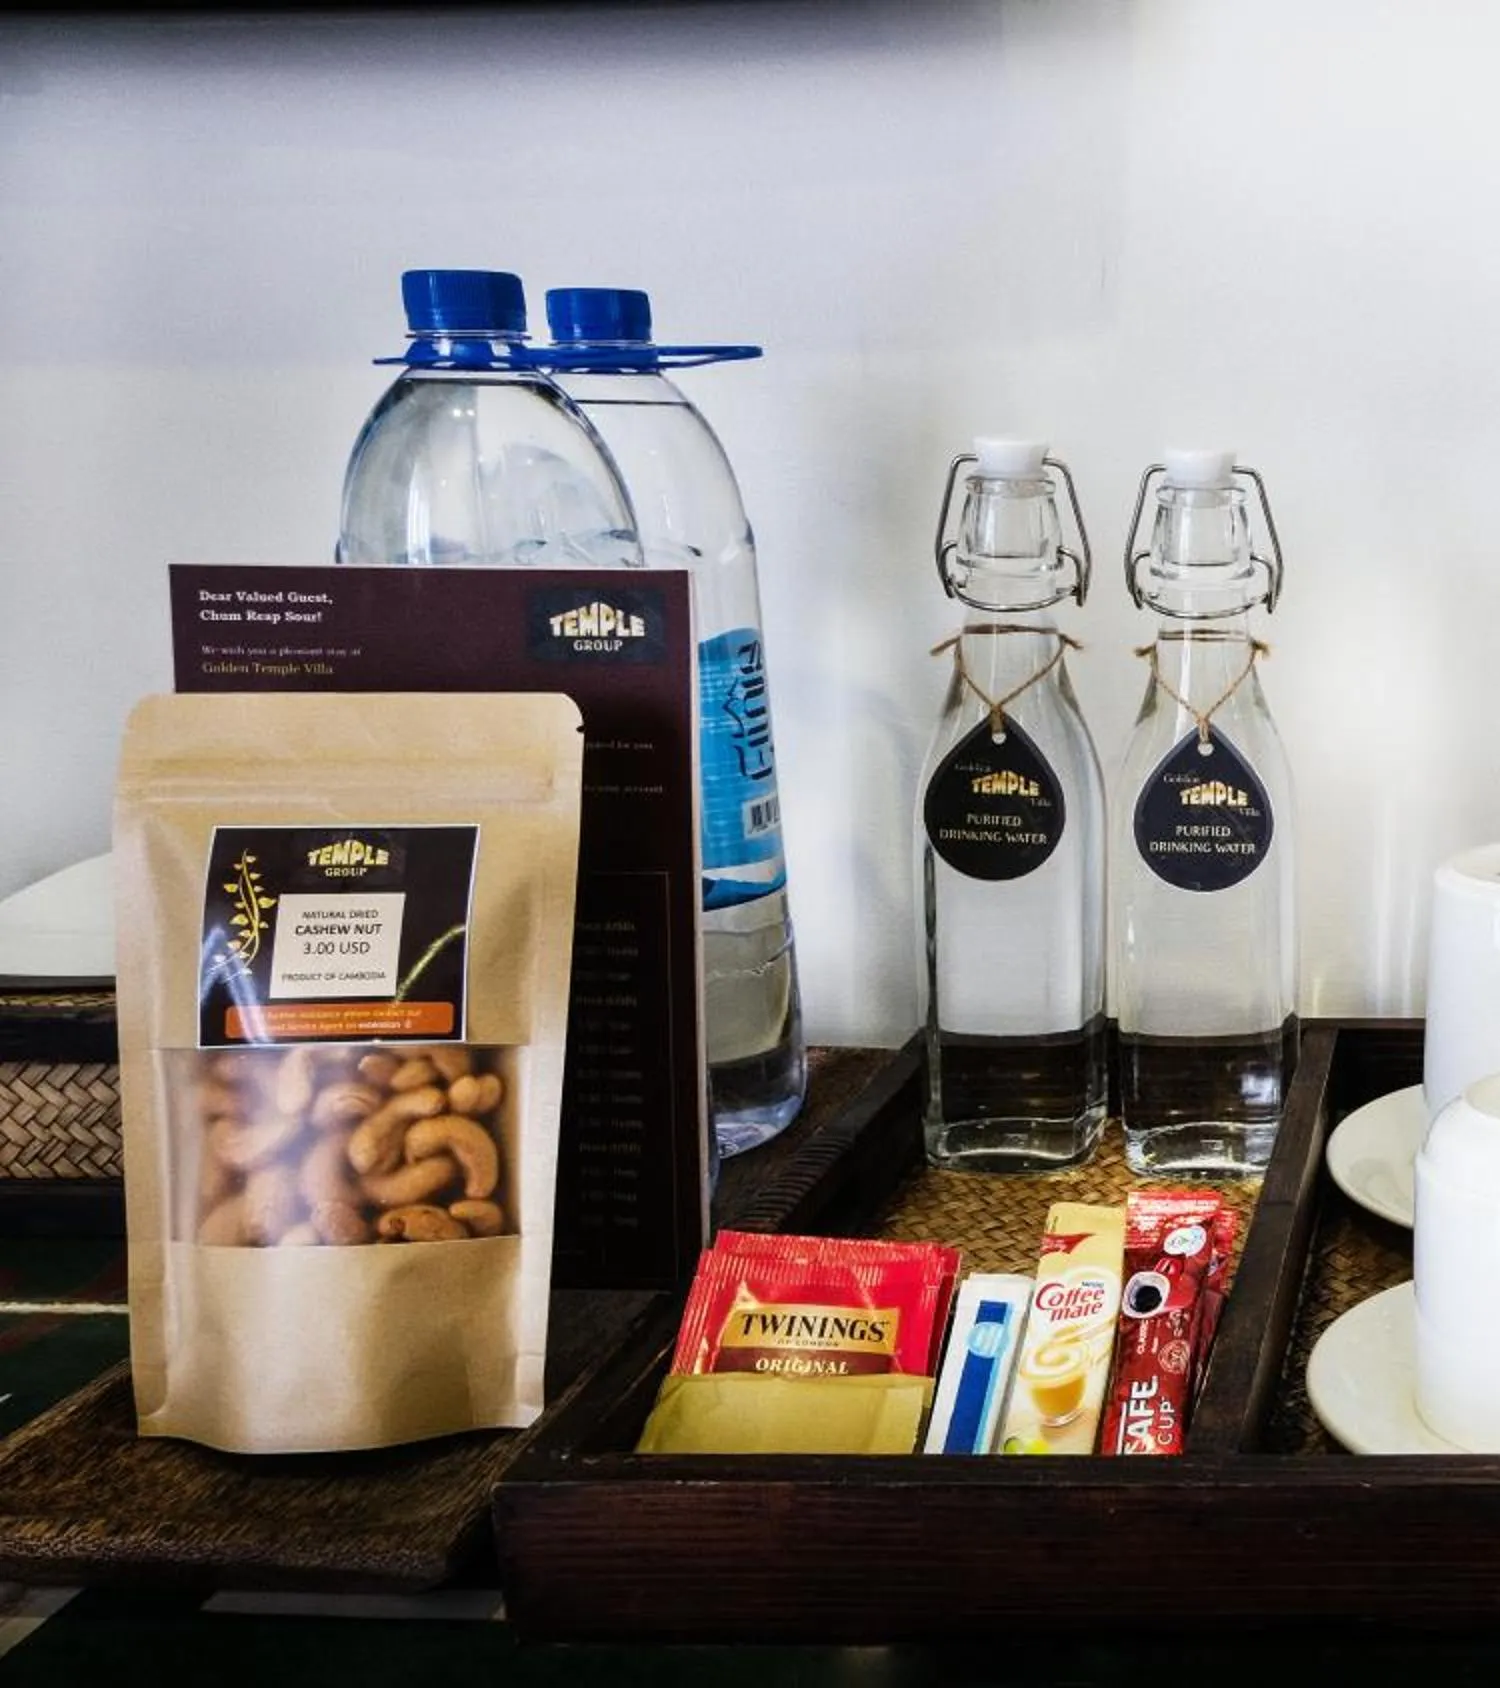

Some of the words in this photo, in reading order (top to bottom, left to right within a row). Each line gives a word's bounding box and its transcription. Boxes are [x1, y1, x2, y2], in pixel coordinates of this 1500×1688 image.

[199, 590, 232, 601] Dear
[236, 592, 284, 602] Valued
[288, 592, 334, 605] Guest,
[200, 609, 242, 621] Chum
[247, 610, 281, 624] Reap
[549, 601, 645, 637] TEMPLE
[573, 639, 623, 651] GROUP
[202, 662, 249, 674] Golden
[253, 662, 300, 676] Temple
[303, 663, 334, 674] Villa
[971, 770, 1040, 796] TEMPLE
[1180, 781, 1248, 806] TEMPLE
[967, 813, 1022, 827] PURIFIED
[940, 829, 1002, 843] DRINKING
[1005, 832, 1047, 845] WATER
[1176, 825, 1231, 837] PURIFIED
[307, 840, 389, 866] TEMPLE
[1149, 841, 1212, 853] DRINKING
[1215, 842, 1256, 854] WATER
[325, 867, 368, 877] GROUP
[302, 910, 346, 919] NATURAL
[349, 909, 379, 918] DRIED
[295, 924, 351, 935] CASHEW
[354, 923, 383, 935] NUT
[304, 941, 335, 955] 3.00
[339, 941, 371, 955] USD
[1035, 1282, 1105, 1311] Coffee
[1050, 1301, 1103, 1322] mate
[741, 1313, 885, 1343] TWININGS
[755, 1356, 849, 1375] ORIGINAL
[1157, 1400, 1175, 1446] CUP
